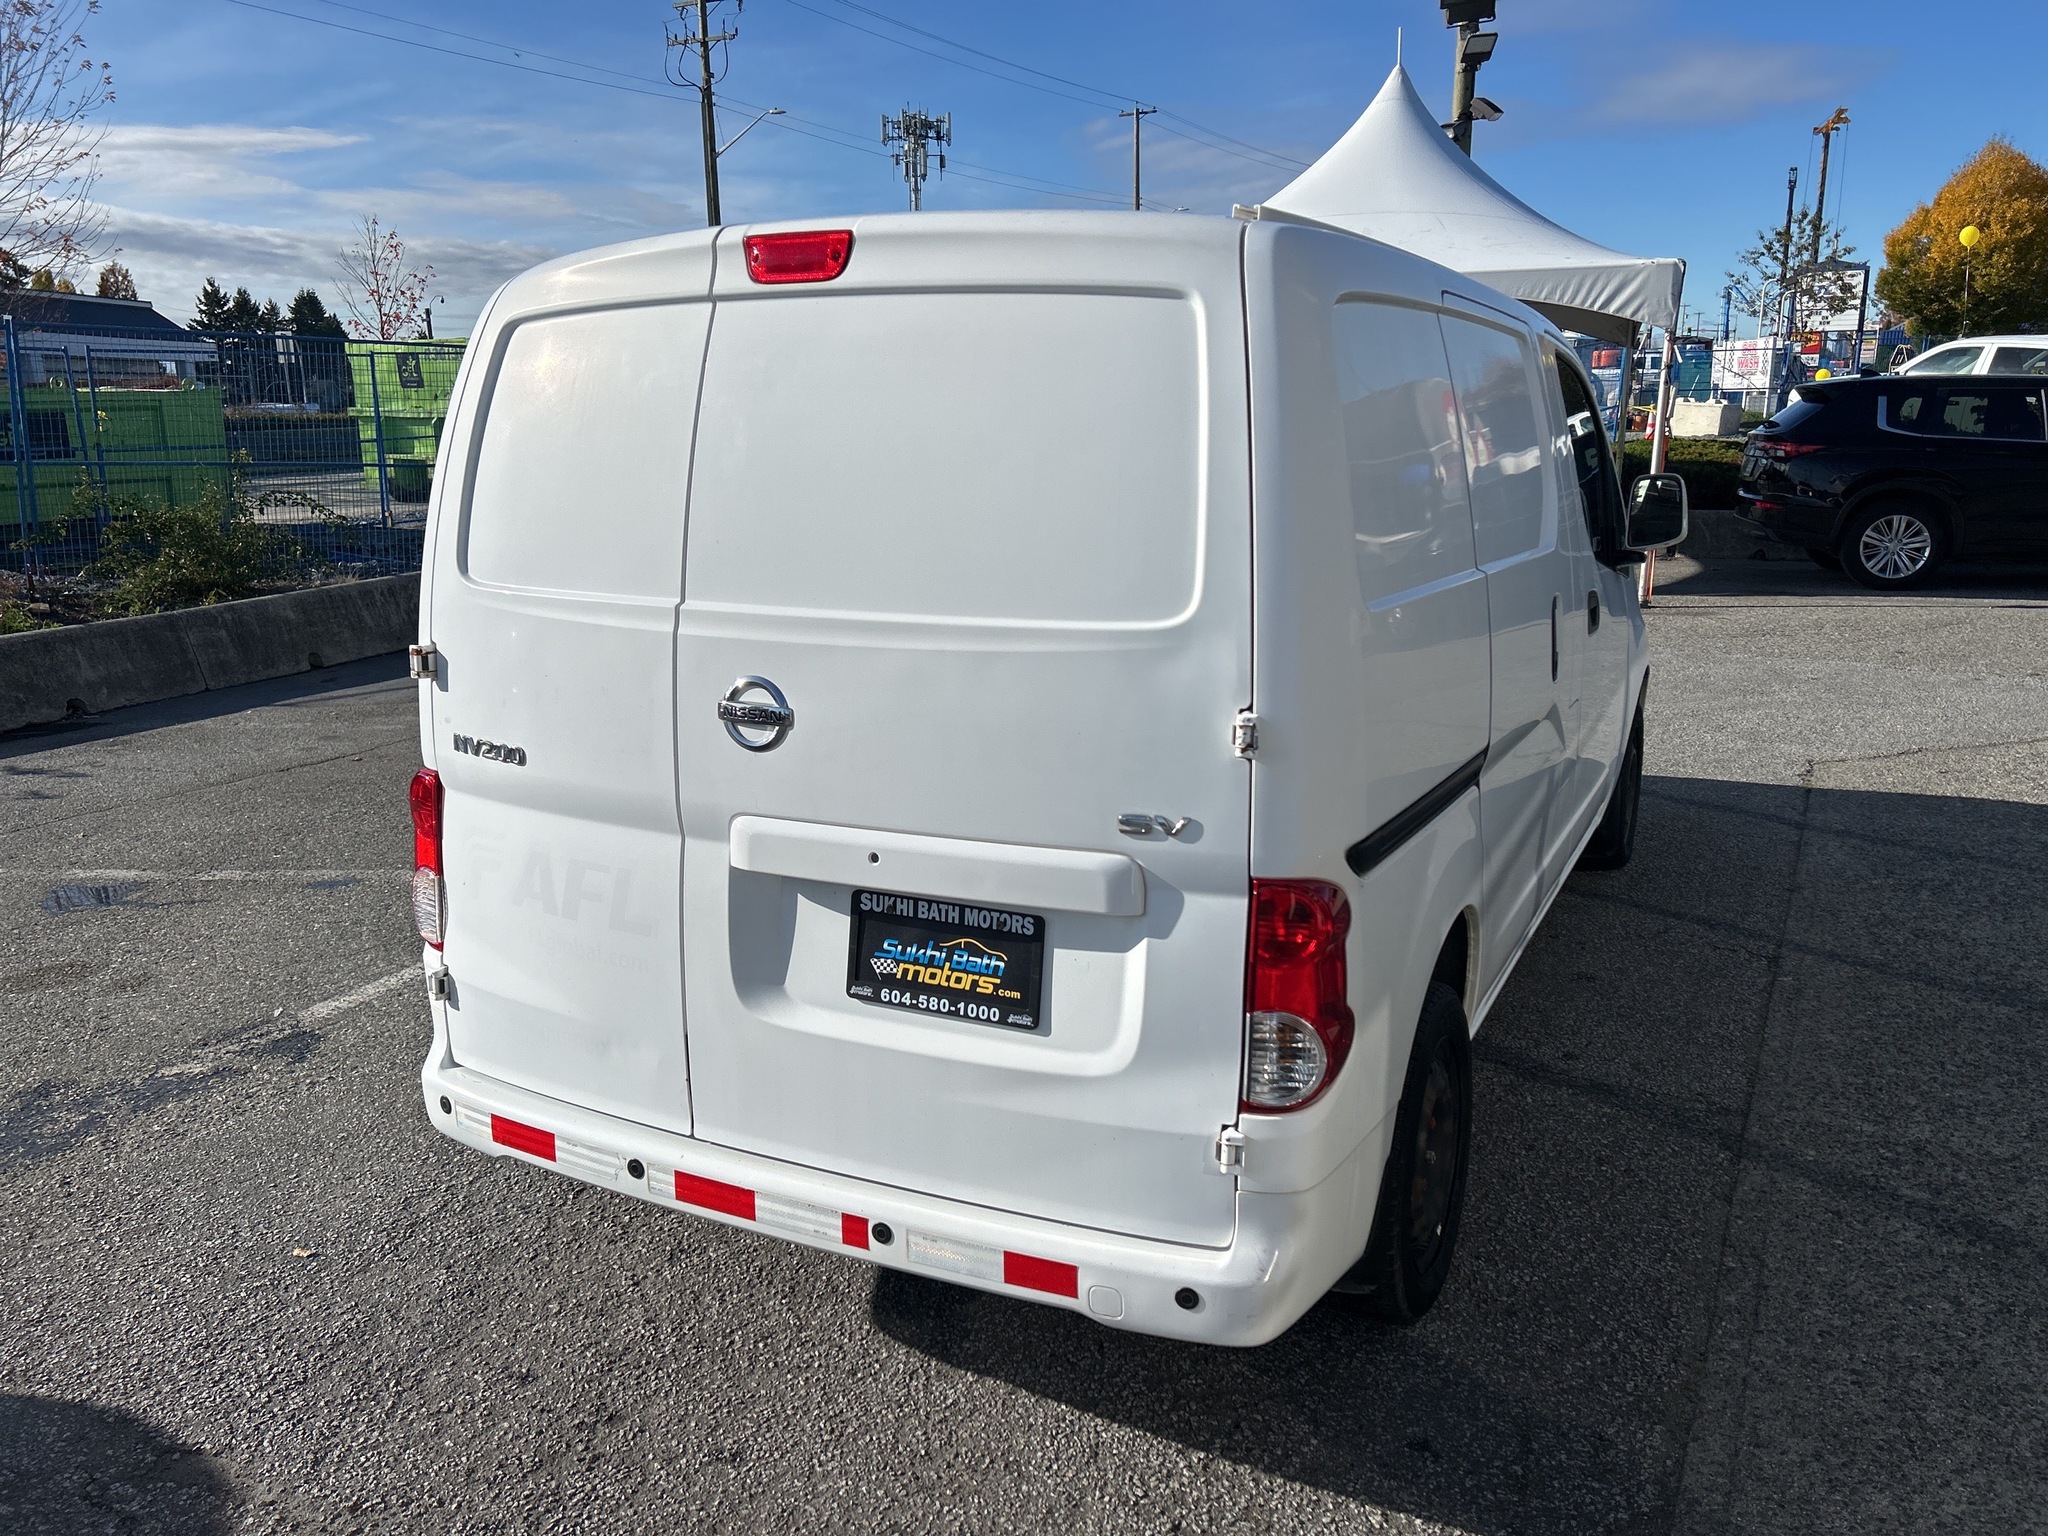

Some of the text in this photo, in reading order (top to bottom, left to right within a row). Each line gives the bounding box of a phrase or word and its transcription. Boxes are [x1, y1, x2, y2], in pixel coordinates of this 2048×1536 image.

[1737, 357, 1759, 369] WASH
[723, 704, 782, 723] NISSAN
[453, 732, 528, 767] NV200
[1118, 814, 1192, 836] SV
[511, 849, 657, 938] AFL
[860, 892, 1035, 936] SUKHI BATH MOTORS
[874, 938, 1006, 977] Sukhi Bath
[880, 988, 1001, 1022] 604-580-1000
